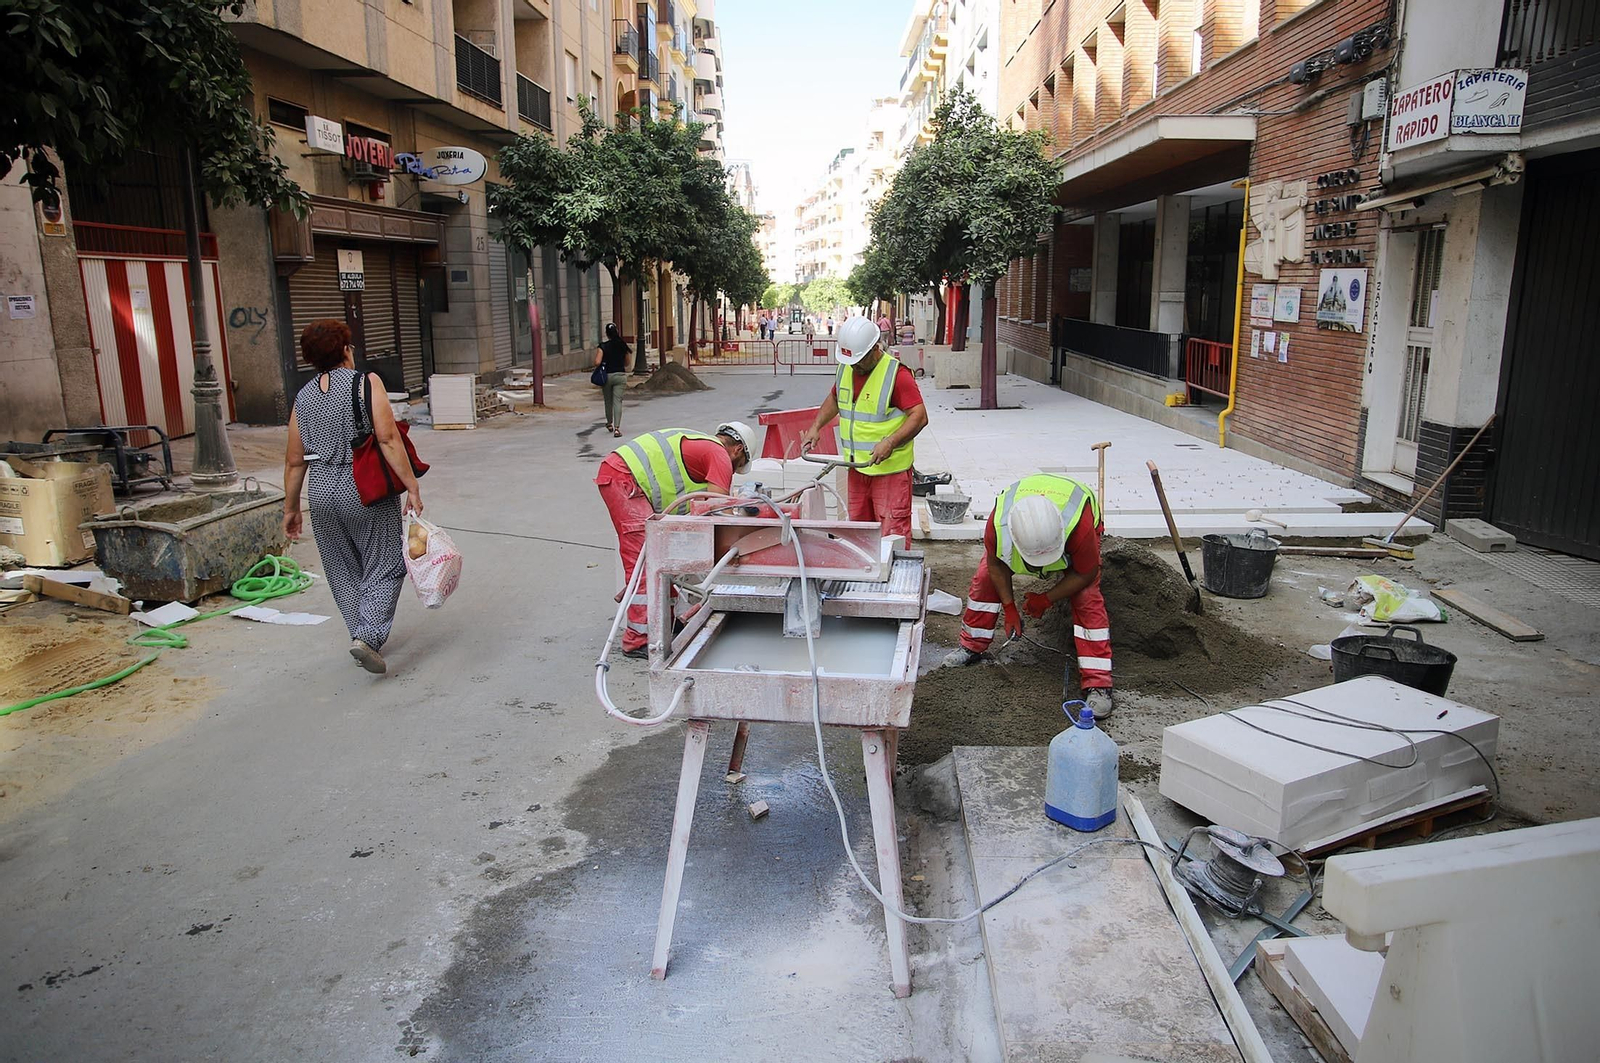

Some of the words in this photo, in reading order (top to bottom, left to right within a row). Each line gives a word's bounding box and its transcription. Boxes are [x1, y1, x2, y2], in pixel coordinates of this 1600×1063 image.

[1457, 70, 1526, 91] ZAPATERIA
[1392, 79, 1453, 117] ZAPATERO
[1396, 114, 1439, 144] RAPIDO
[1453, 113, 1506, 128] BLANCA
[317, 129, 342, 144] TISSOT
[346, 133, 395, 170] JOYERIA
[476, 236, 485, 251] 25
[1367, 282, 1382, 375] ZAPATERO
